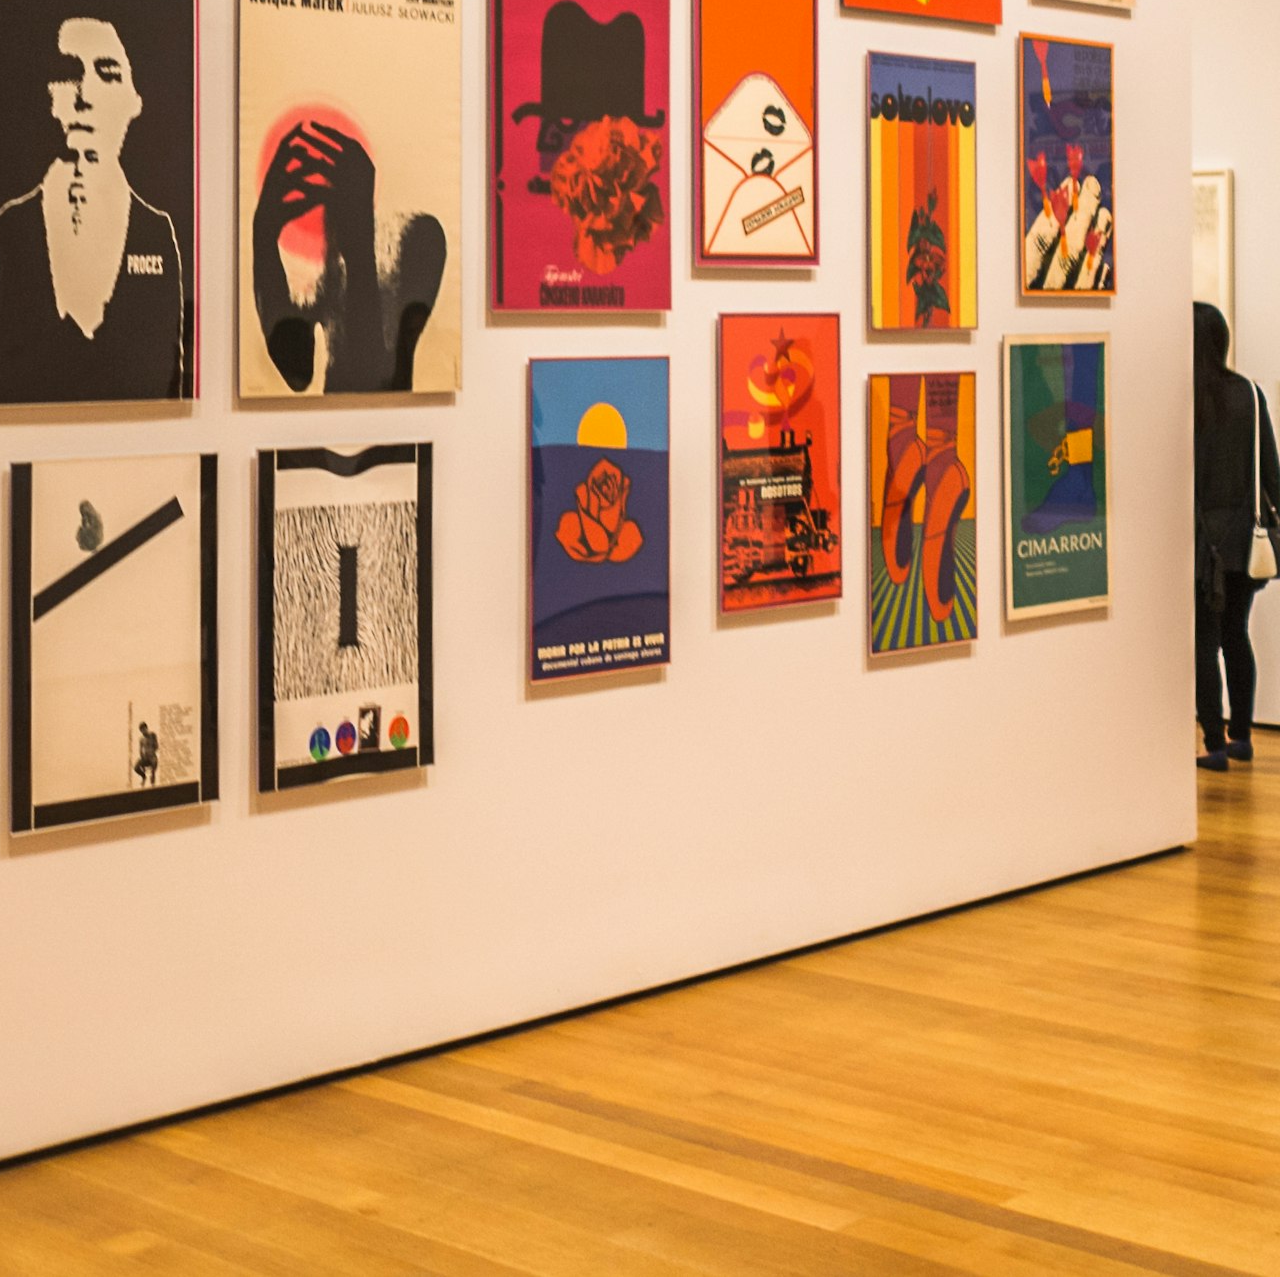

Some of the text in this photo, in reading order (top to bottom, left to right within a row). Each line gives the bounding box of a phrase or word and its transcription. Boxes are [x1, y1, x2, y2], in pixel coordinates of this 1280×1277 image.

[351, 0, 456, 25] JULIUSZ SŁOWACKI
[126, 253, 164, 275] PROCES
[760, 481, 803, 500] NOSOTROS
[1016, 531, 1104, 559] CIMARRON
